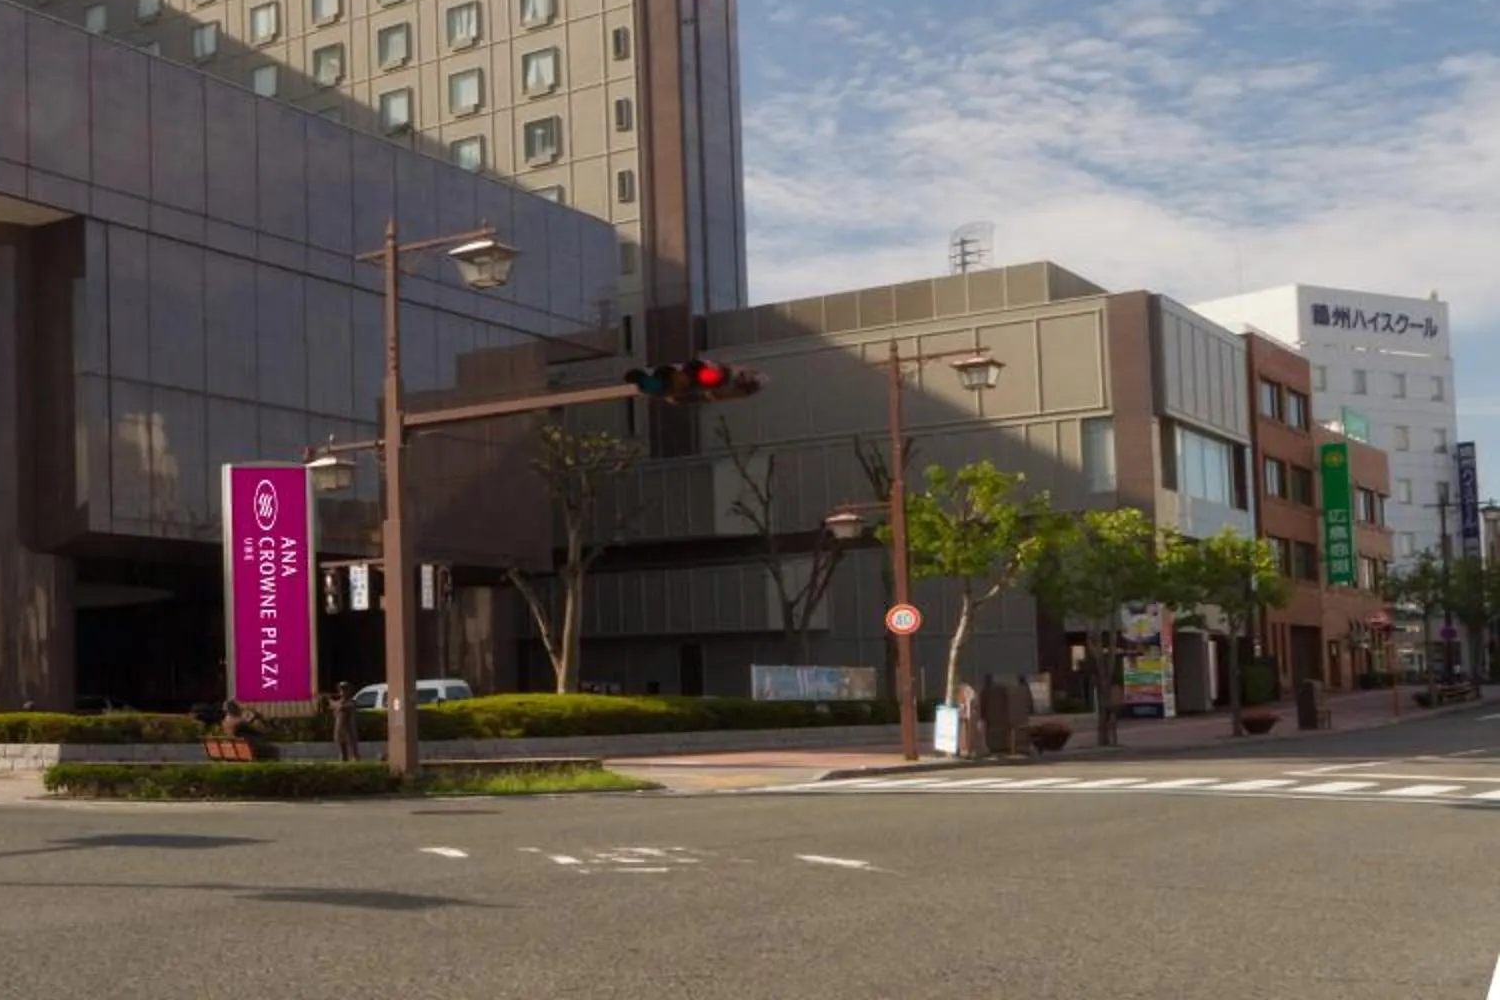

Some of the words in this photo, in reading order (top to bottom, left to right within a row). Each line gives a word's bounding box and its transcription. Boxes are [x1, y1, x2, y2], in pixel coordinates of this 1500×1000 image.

[259, 536, 277, 619] CROWNE
[280, 536, 299, 577] ANA
[261, 626, 278, 689] PLAZA
